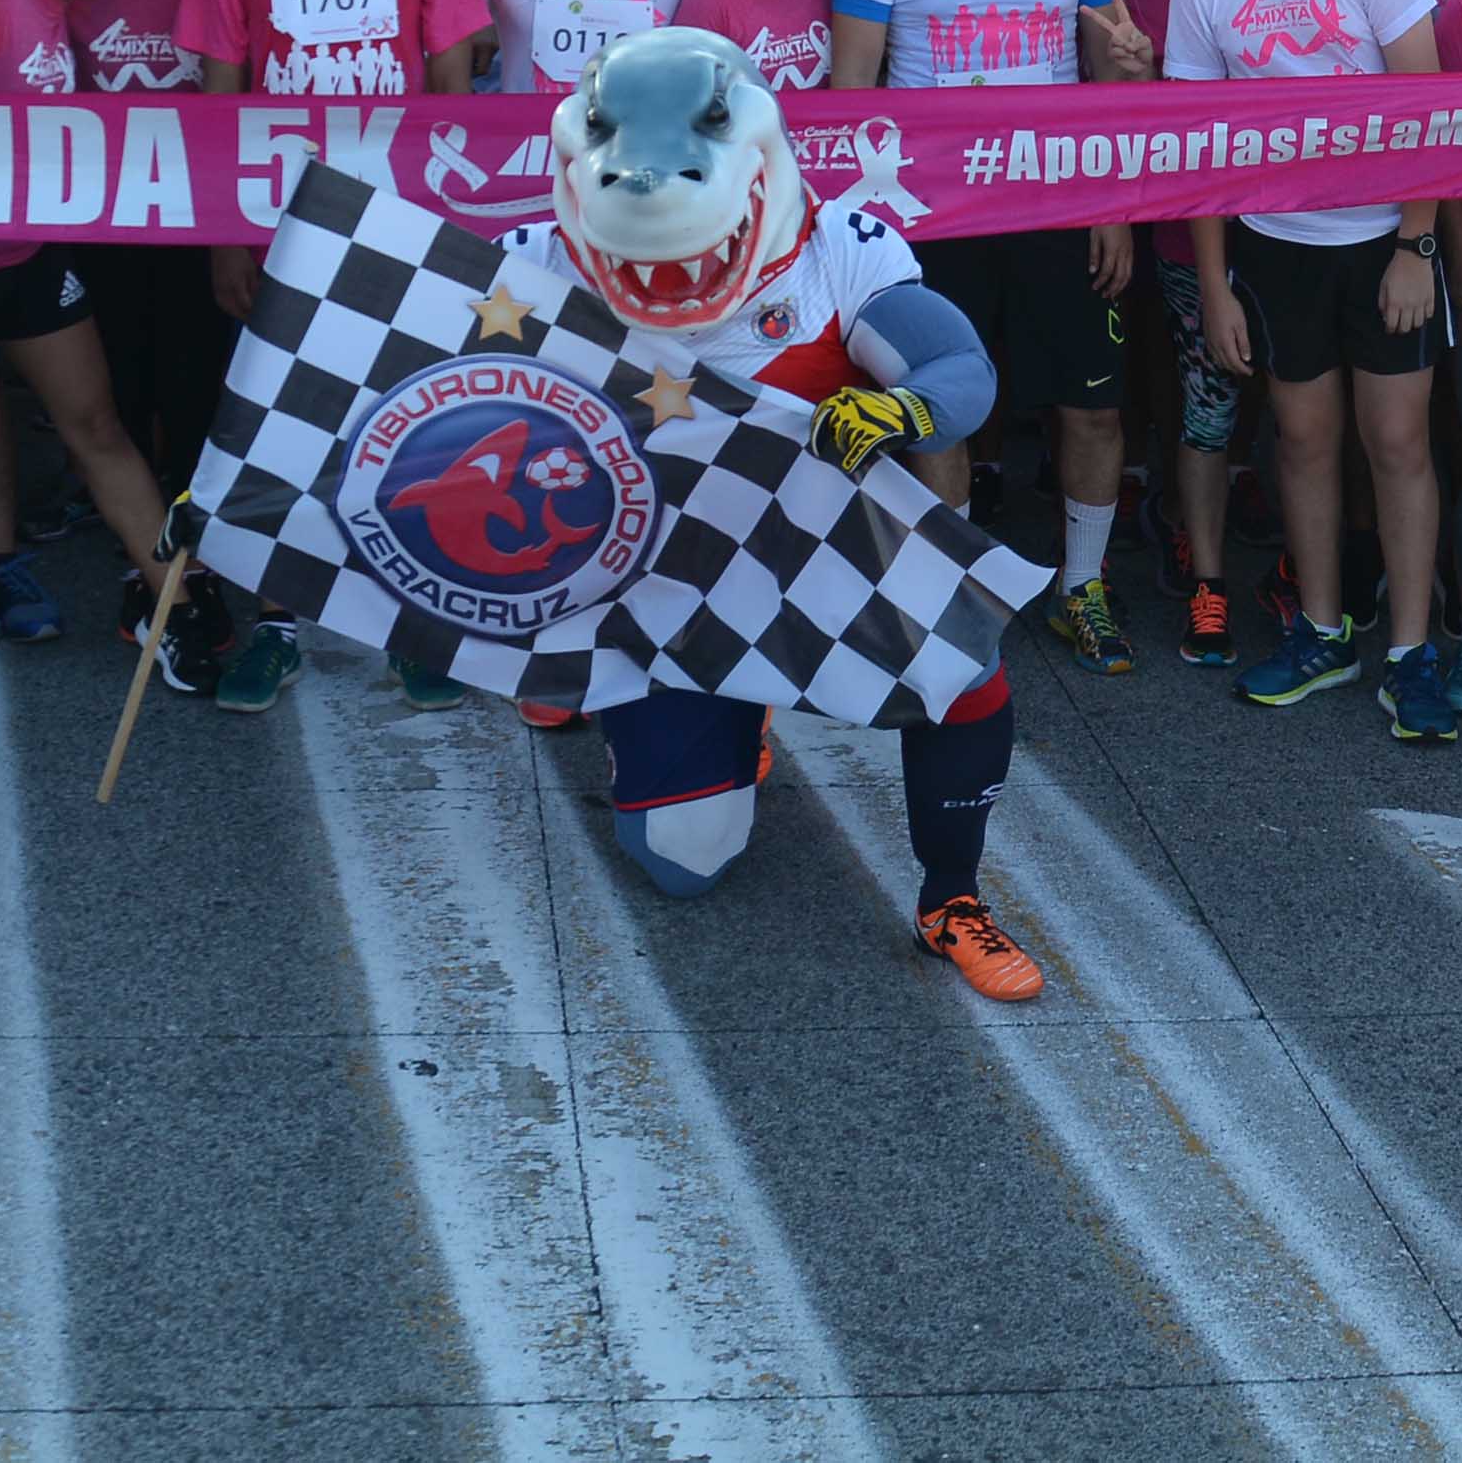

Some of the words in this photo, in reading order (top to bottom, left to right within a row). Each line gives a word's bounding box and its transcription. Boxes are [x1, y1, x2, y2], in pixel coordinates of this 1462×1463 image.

[1254, 5, 1312, 27] MIXTA
[114, 40, 175, 56] MIXTA
[553, 28, 629, 54] 011
[768, 38, 815, 62] MIXTA
[791, 136, 856, 160] XTA
[238, 106, 407, 229] 5K
[355, 368, 608, 470] TIBURONES
[349, 509, 580, 629] VERACRUZ
